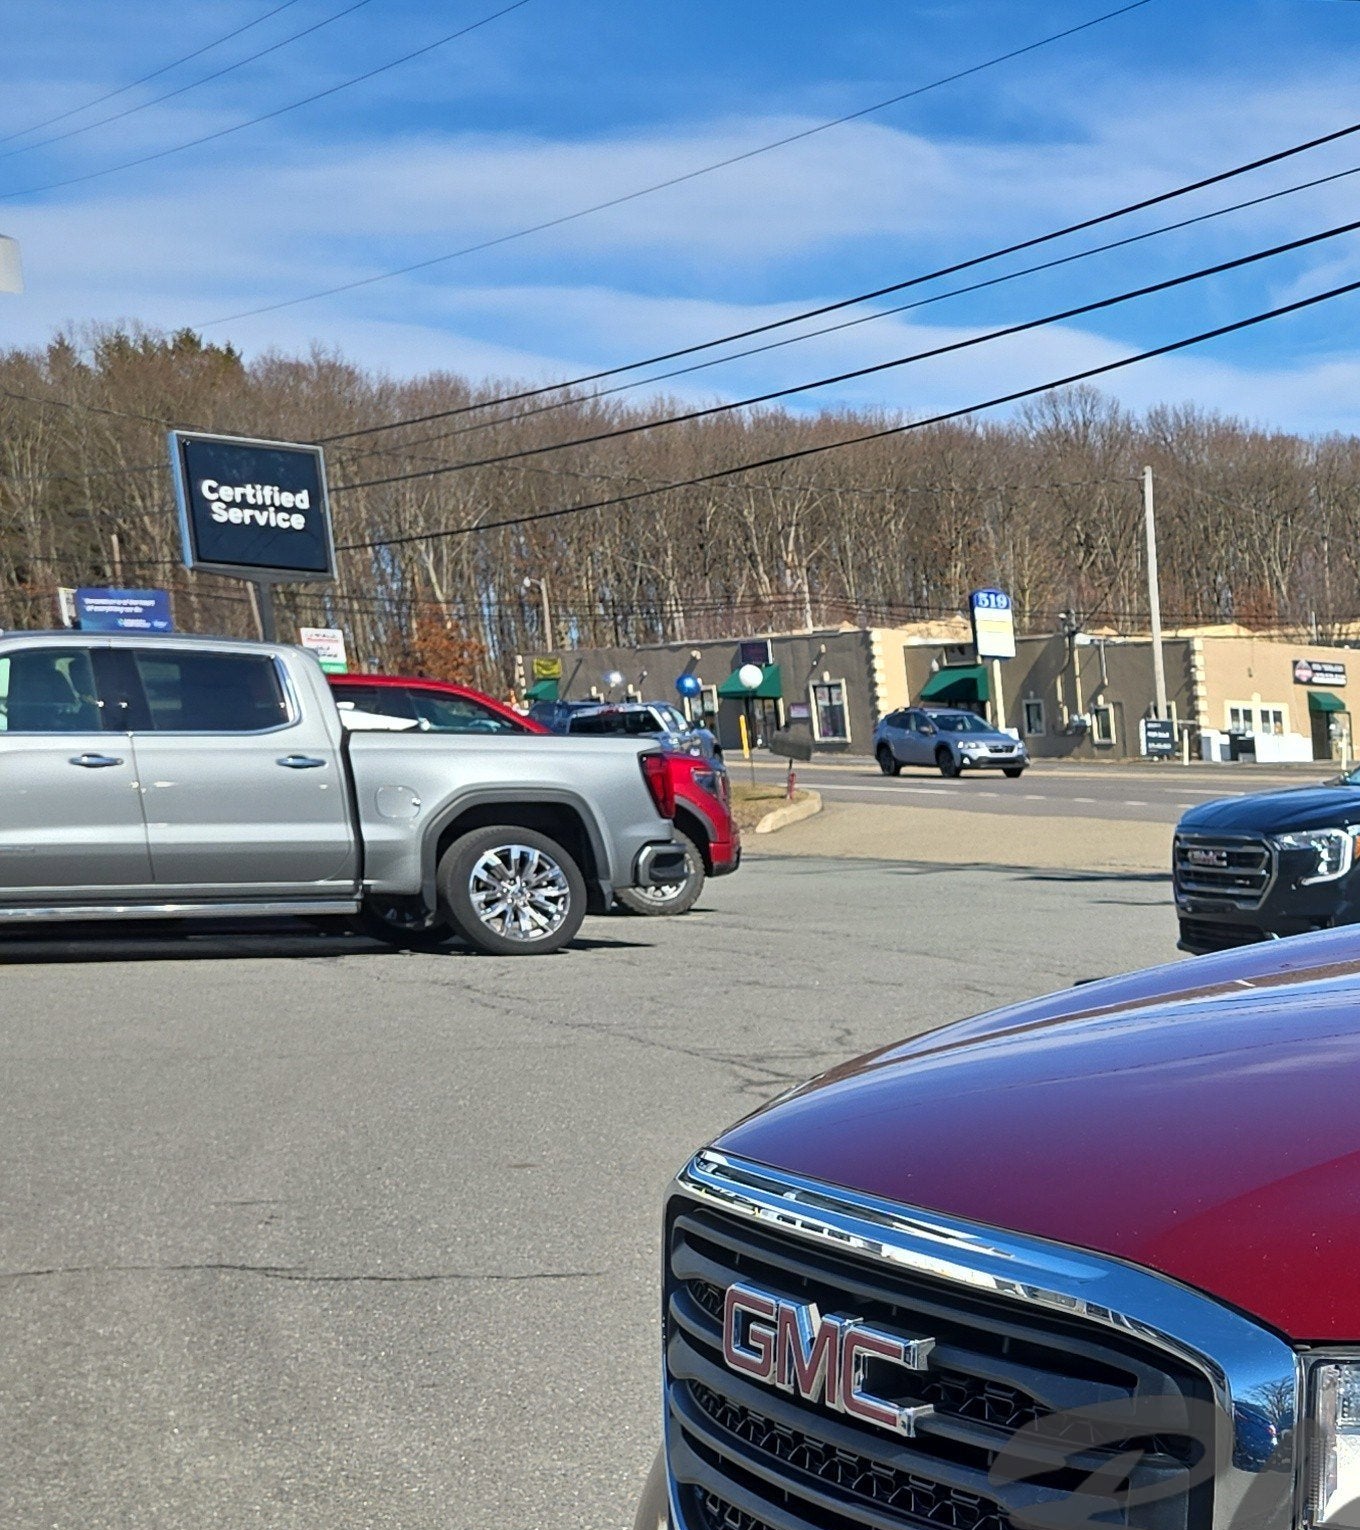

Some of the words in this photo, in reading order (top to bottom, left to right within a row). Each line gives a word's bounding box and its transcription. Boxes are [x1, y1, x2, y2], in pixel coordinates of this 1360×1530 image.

[201, 479, 310, 510] Certified
[210, 501, 306, 530] Service
[977, 592, 1008, 609] 519
[723, 1281, 936, 1438] GMC
